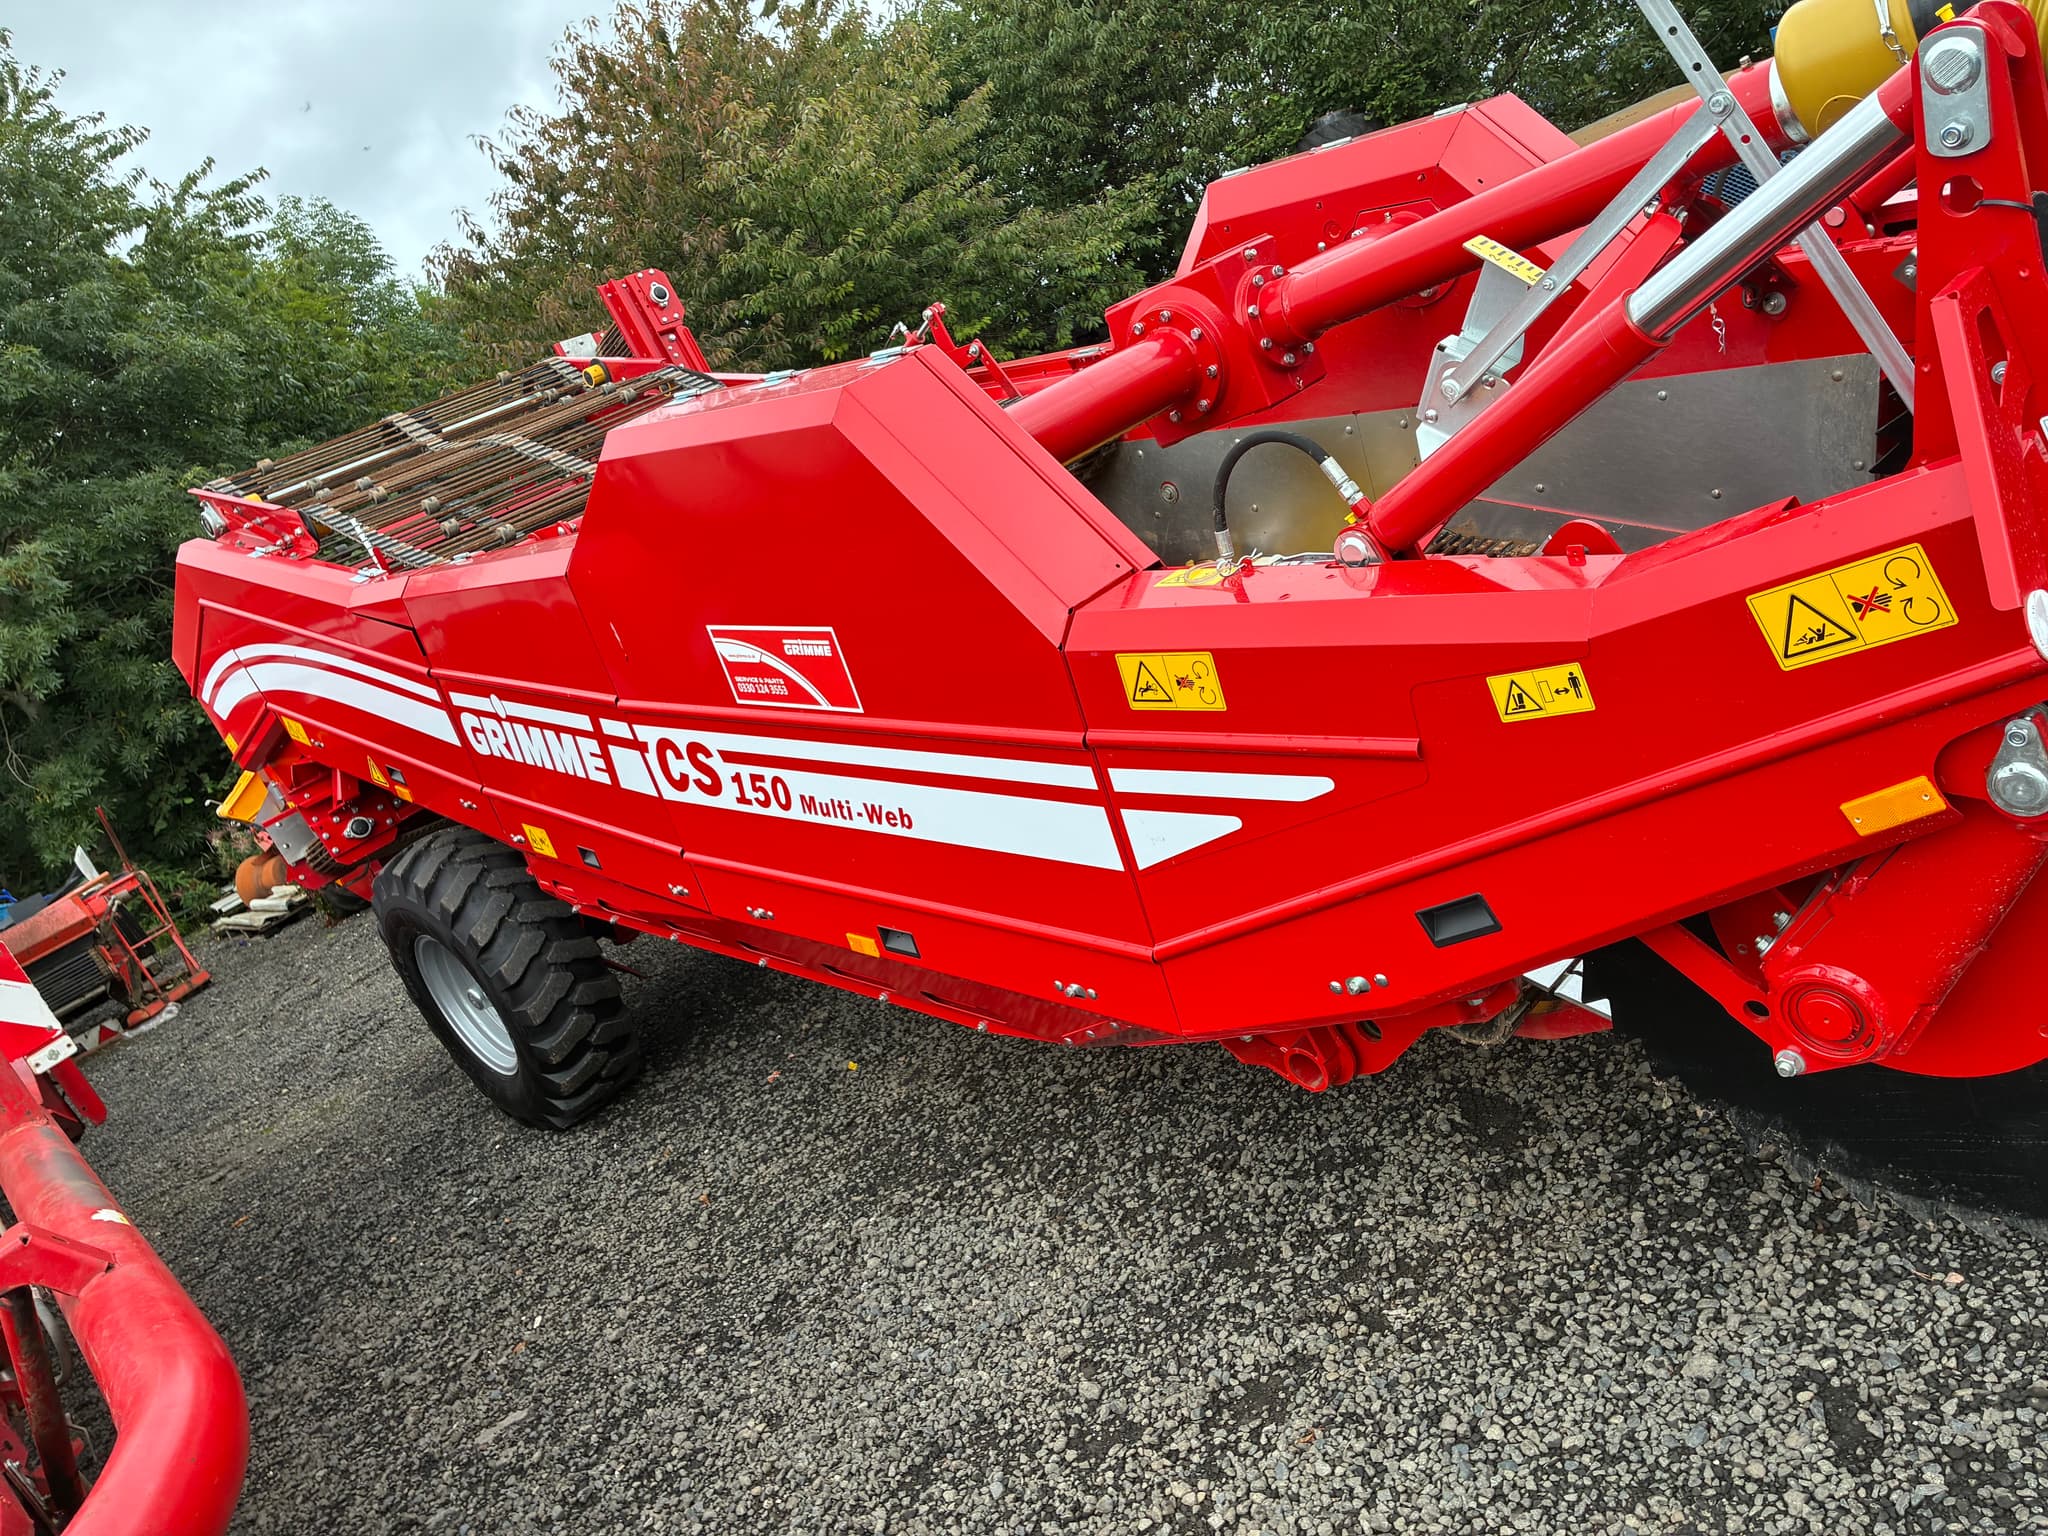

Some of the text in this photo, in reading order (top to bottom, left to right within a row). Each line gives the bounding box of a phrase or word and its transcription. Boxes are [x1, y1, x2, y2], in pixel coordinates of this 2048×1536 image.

[783, 641, 832, 657] GRIMME
[737, 682, 789, 696] 0330 124 3553
[460, 696, 612, 785] GRIMME
[656, 737, 723, 797] CS
[731, 771, 792, 812] 150
